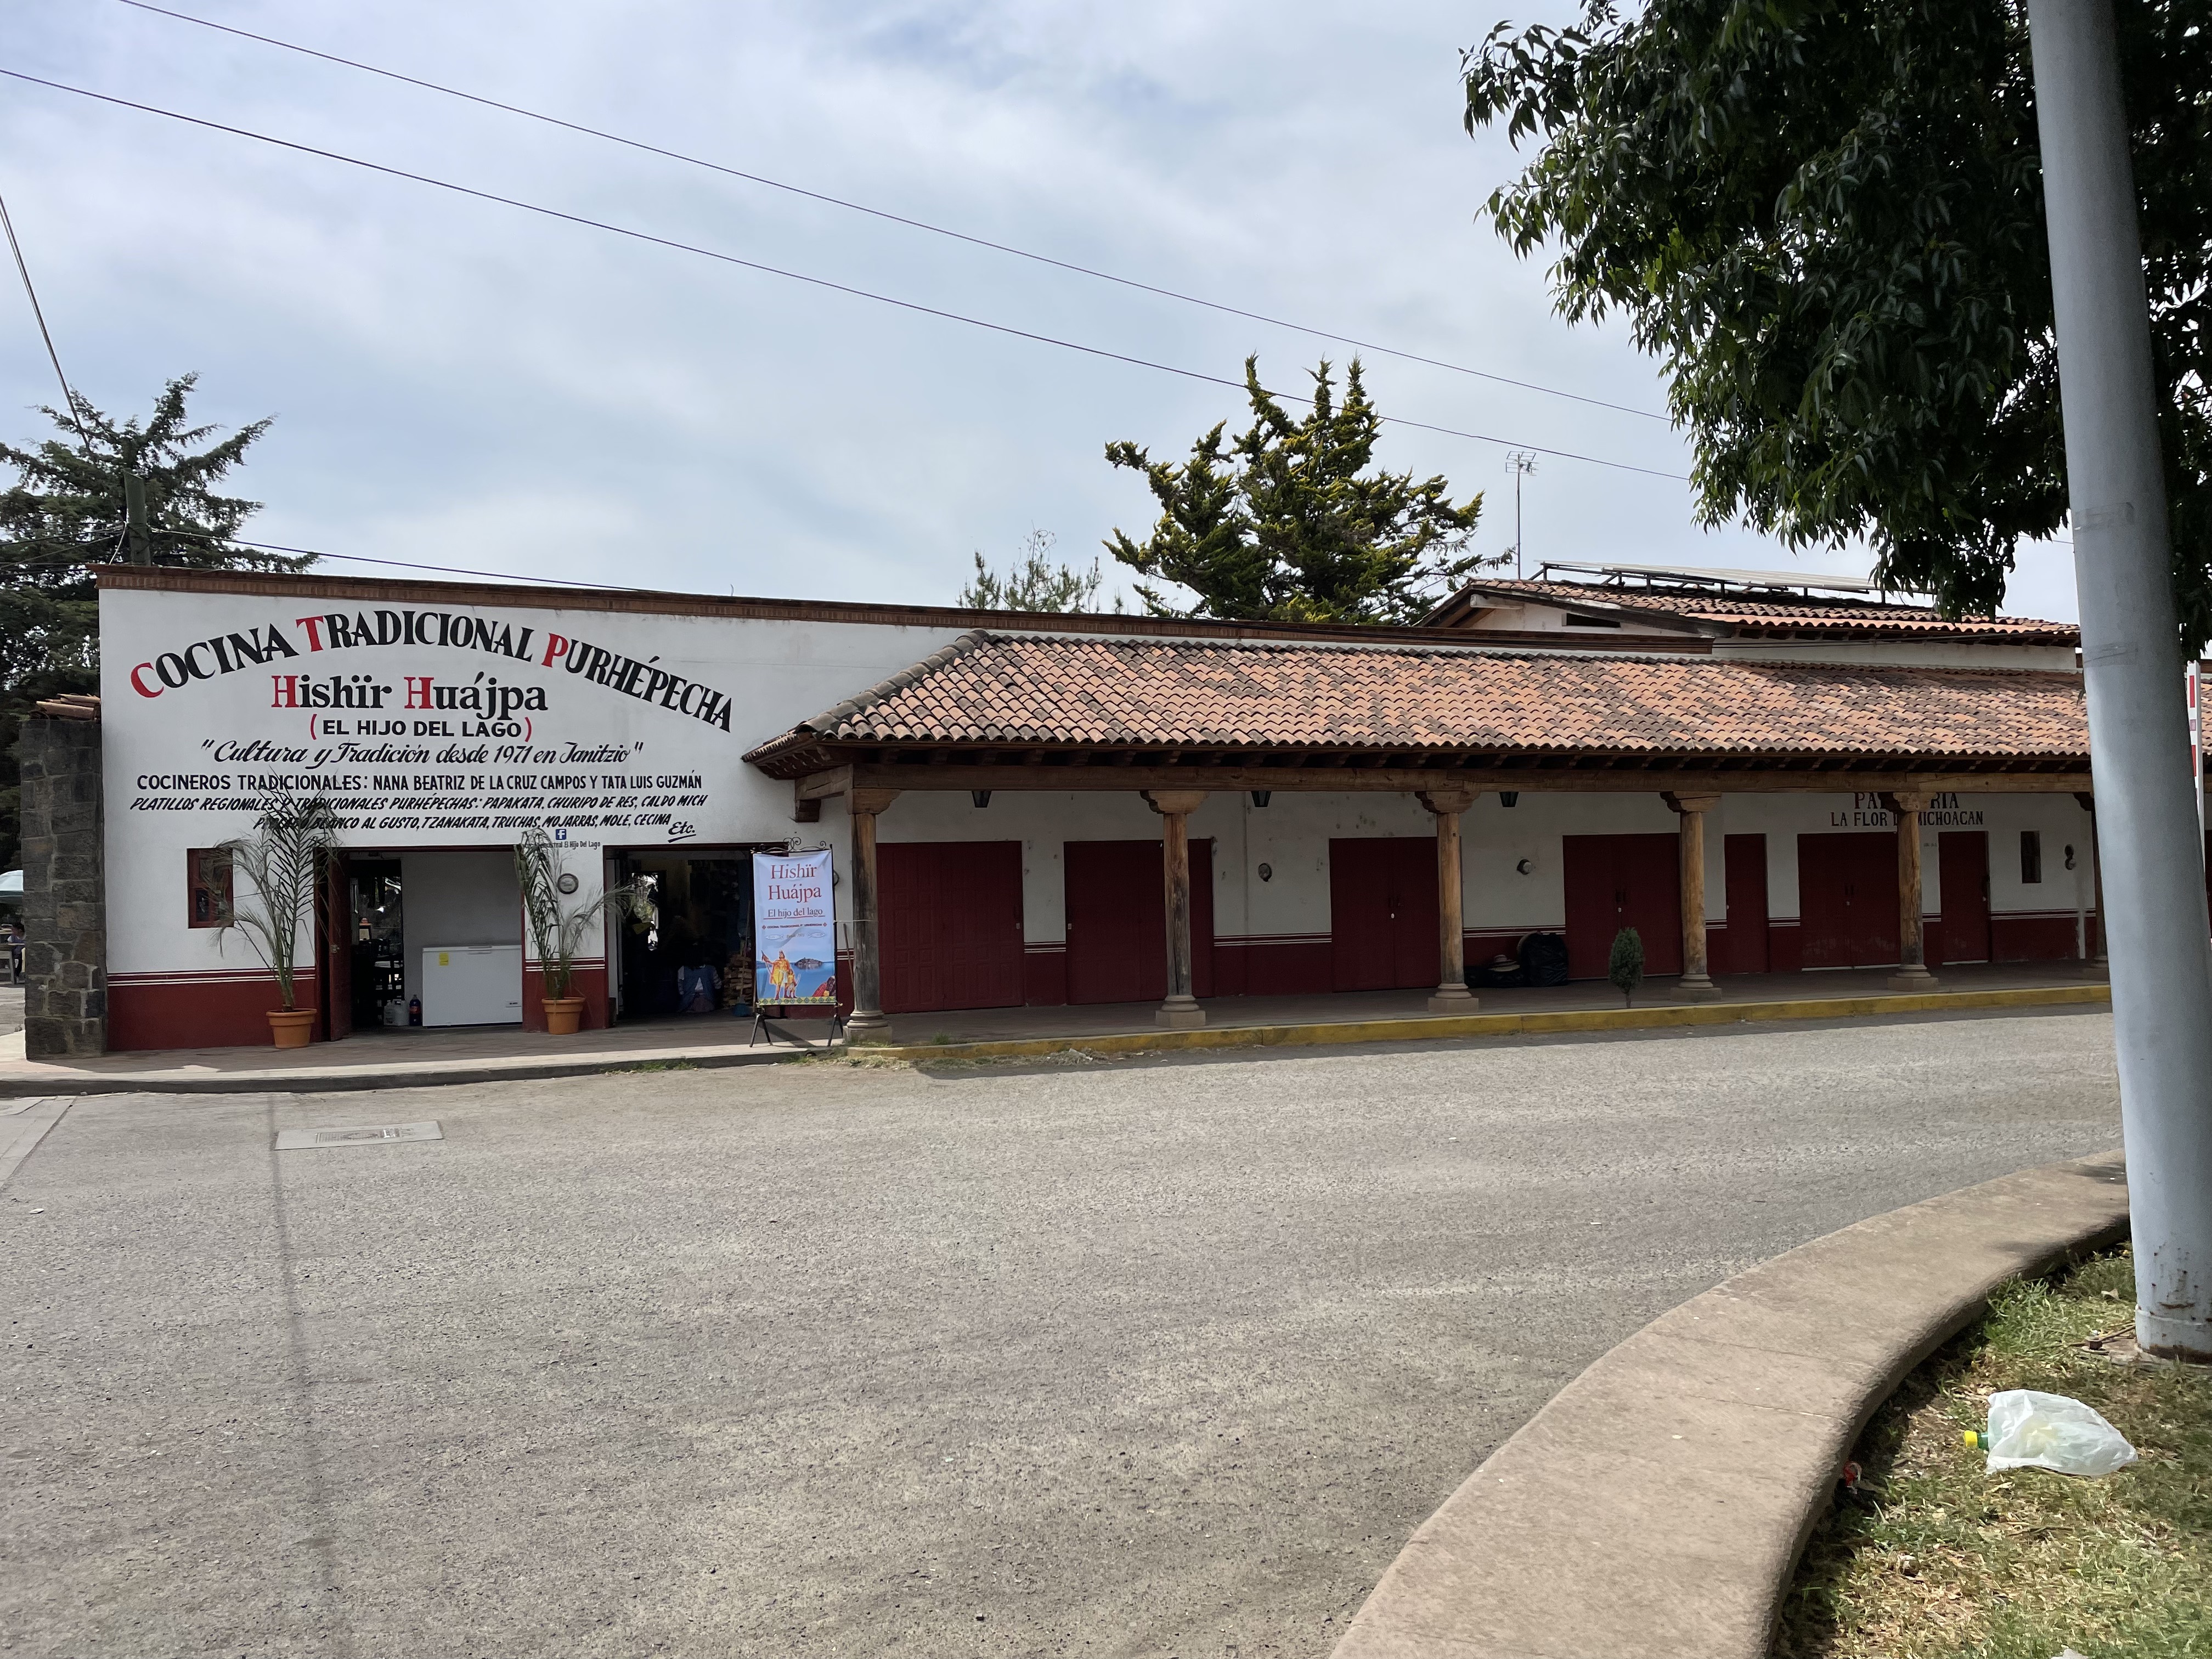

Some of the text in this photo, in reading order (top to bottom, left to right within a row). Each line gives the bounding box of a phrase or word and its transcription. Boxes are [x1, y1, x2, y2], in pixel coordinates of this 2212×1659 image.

[130, 610, 732, 733] COCINA TRADICIONAL PURHÉPECHA
[271, 670, 549, 721] Hishïr Huájpa
[357, 720, 407, 736] HIJO
[414, 721, 455, 737] DEL
[305, 749, 331, 770] y
[330, 742, 430, 763] Tradición
[436, 743, 489, 764] desde
[493, 744, 533, 764] 1971
[534, 751, 557, 764] en
[137, 769, 702, 791] COCINEROS TRADICIONALES: NANA BEATRIZ DE LA CRUZ CAMPOS Y TATA LUIS GUZMÁN
[129, 797, 199, 811] PLATILLOS
[199, 797, 278, 811] REGIONALES
[547, 797, 599, 809] CHURIPO
[599, 796, 617, 809] DE
[615, 795, 638, 810] RES,
[641, 794, 676, 808] CALDO
[676, 794, 708, 806] MICH
[360, 817, 377, 829] AL
[379, 816, 419, 831] GUSTO,
[421, 816, 489, 830] TZANAKATA,
[542, 815, 599, 829] MOJARRAS,
[599, 814, 631, 827] MOLE,
[633, 812, 673, 826] CECINA
[1830, 811, 1848, 826] LA
[1853, 811, 1887, 826] FLOR
[668, 821, 696, 835] Etc.
[569, 840, 579, 850] Hijo
[588, 840, 601, 850] Lago
[769, 883, 822, 903] Huájpa
[768, 909, 776, 917] El
[807, 907, 823, 917] lago
